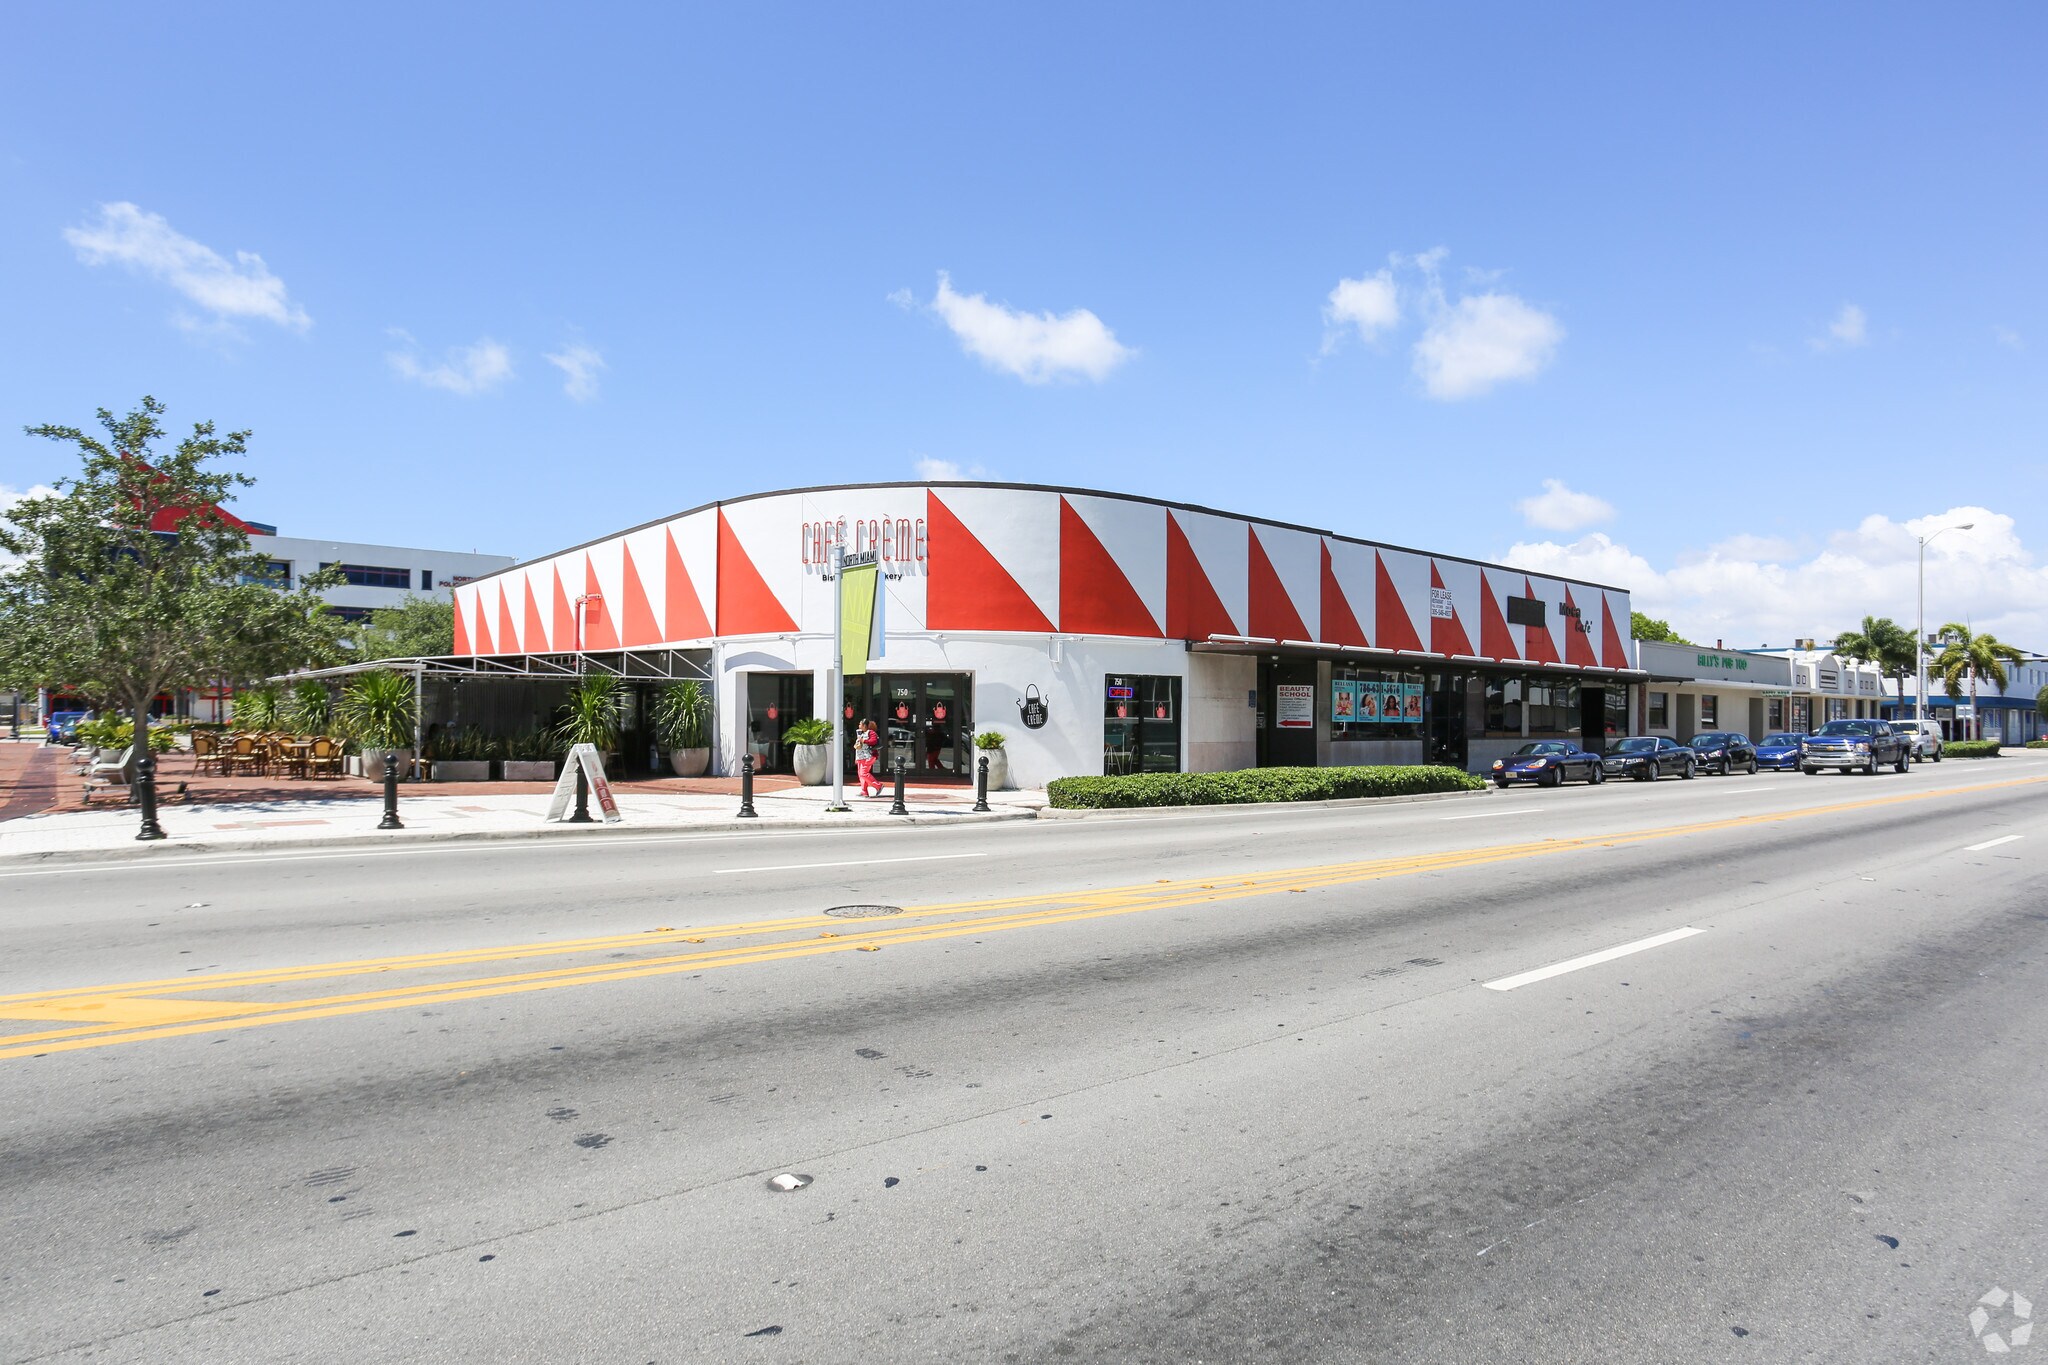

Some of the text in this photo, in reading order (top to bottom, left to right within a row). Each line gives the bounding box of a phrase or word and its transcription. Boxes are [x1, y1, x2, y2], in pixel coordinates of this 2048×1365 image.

[844, 549, 877, 566] NORTH MIAMI
[1431, 589, 1452, 600] FOR LEASE
[1559, 602, 1581, 618] Moca
[1114, 677, 1123, 686] 750
[897, 688, 908, 696] 750
[1110, 688, 1131, 697] OPEN
